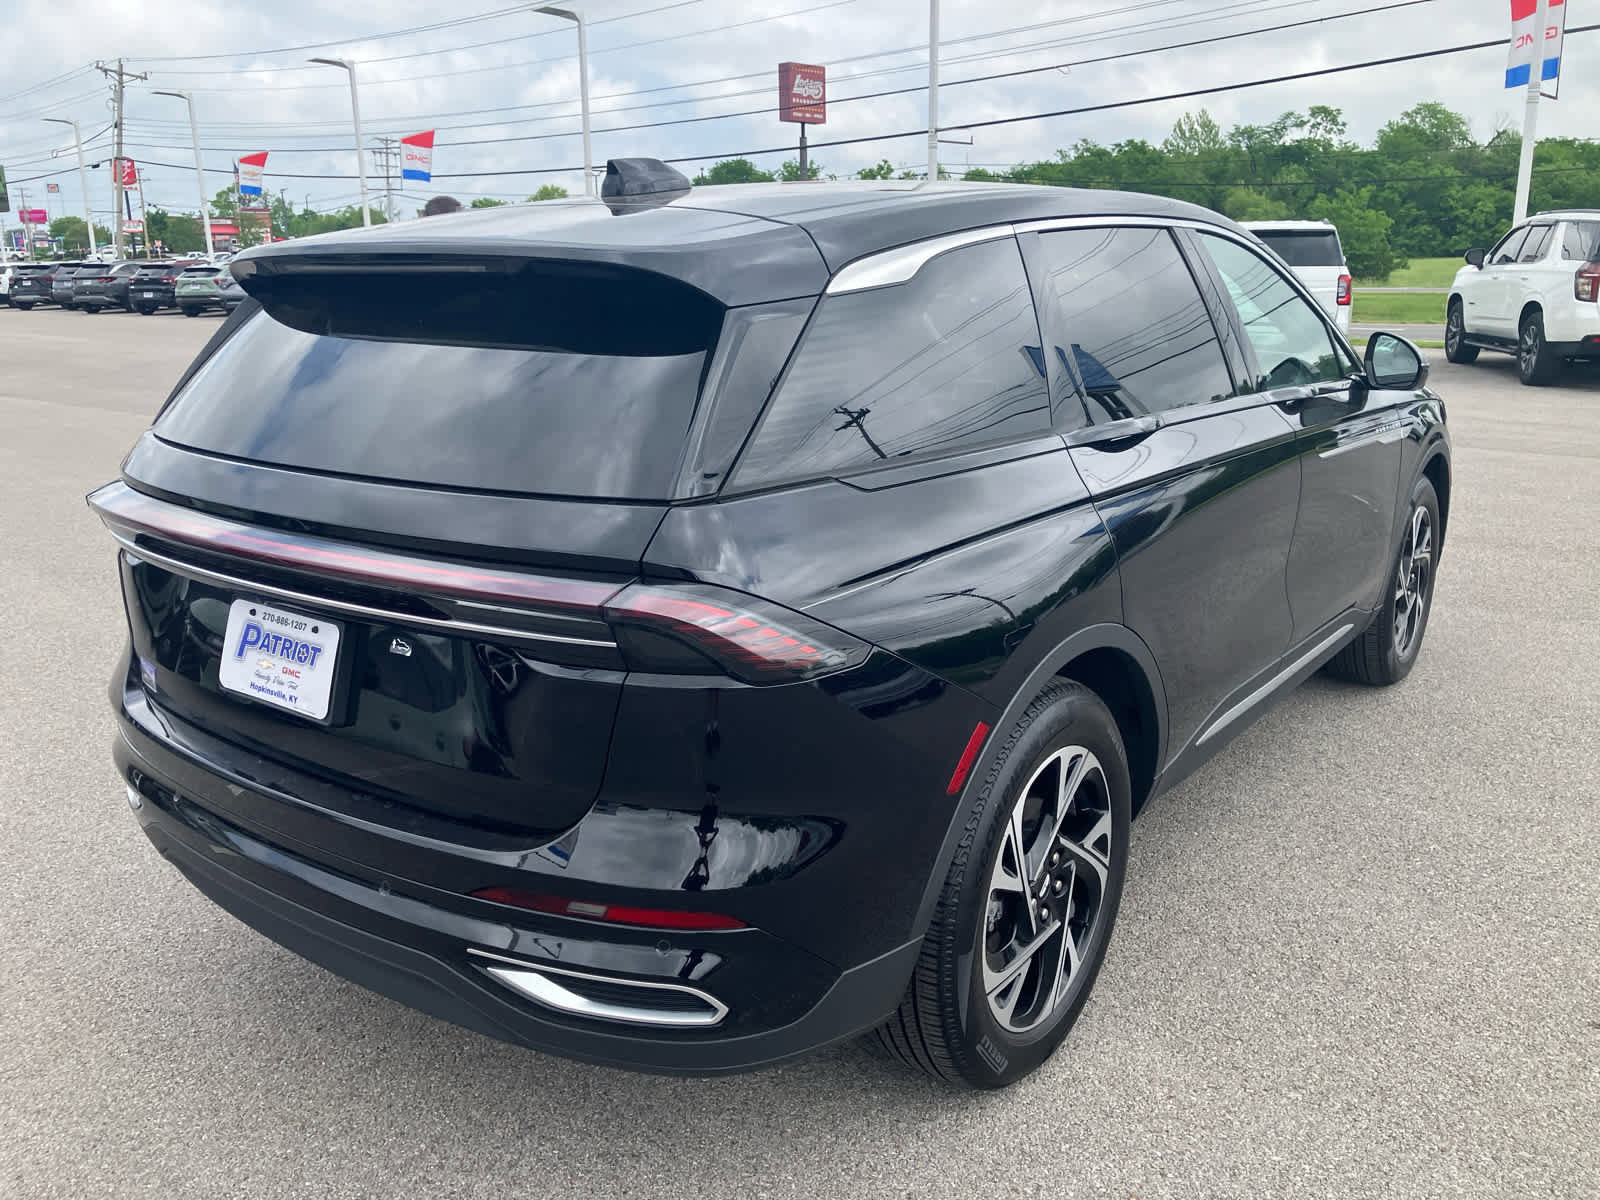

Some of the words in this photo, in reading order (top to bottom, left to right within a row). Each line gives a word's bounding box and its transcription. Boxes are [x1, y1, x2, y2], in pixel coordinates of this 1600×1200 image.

[262, 612, 307, 632] 270-886-1207
[281, 666, 301, 679] GMC
[250, 681, 288, 702] Hopkinsville,
[288, 695, 298, 704] KY
